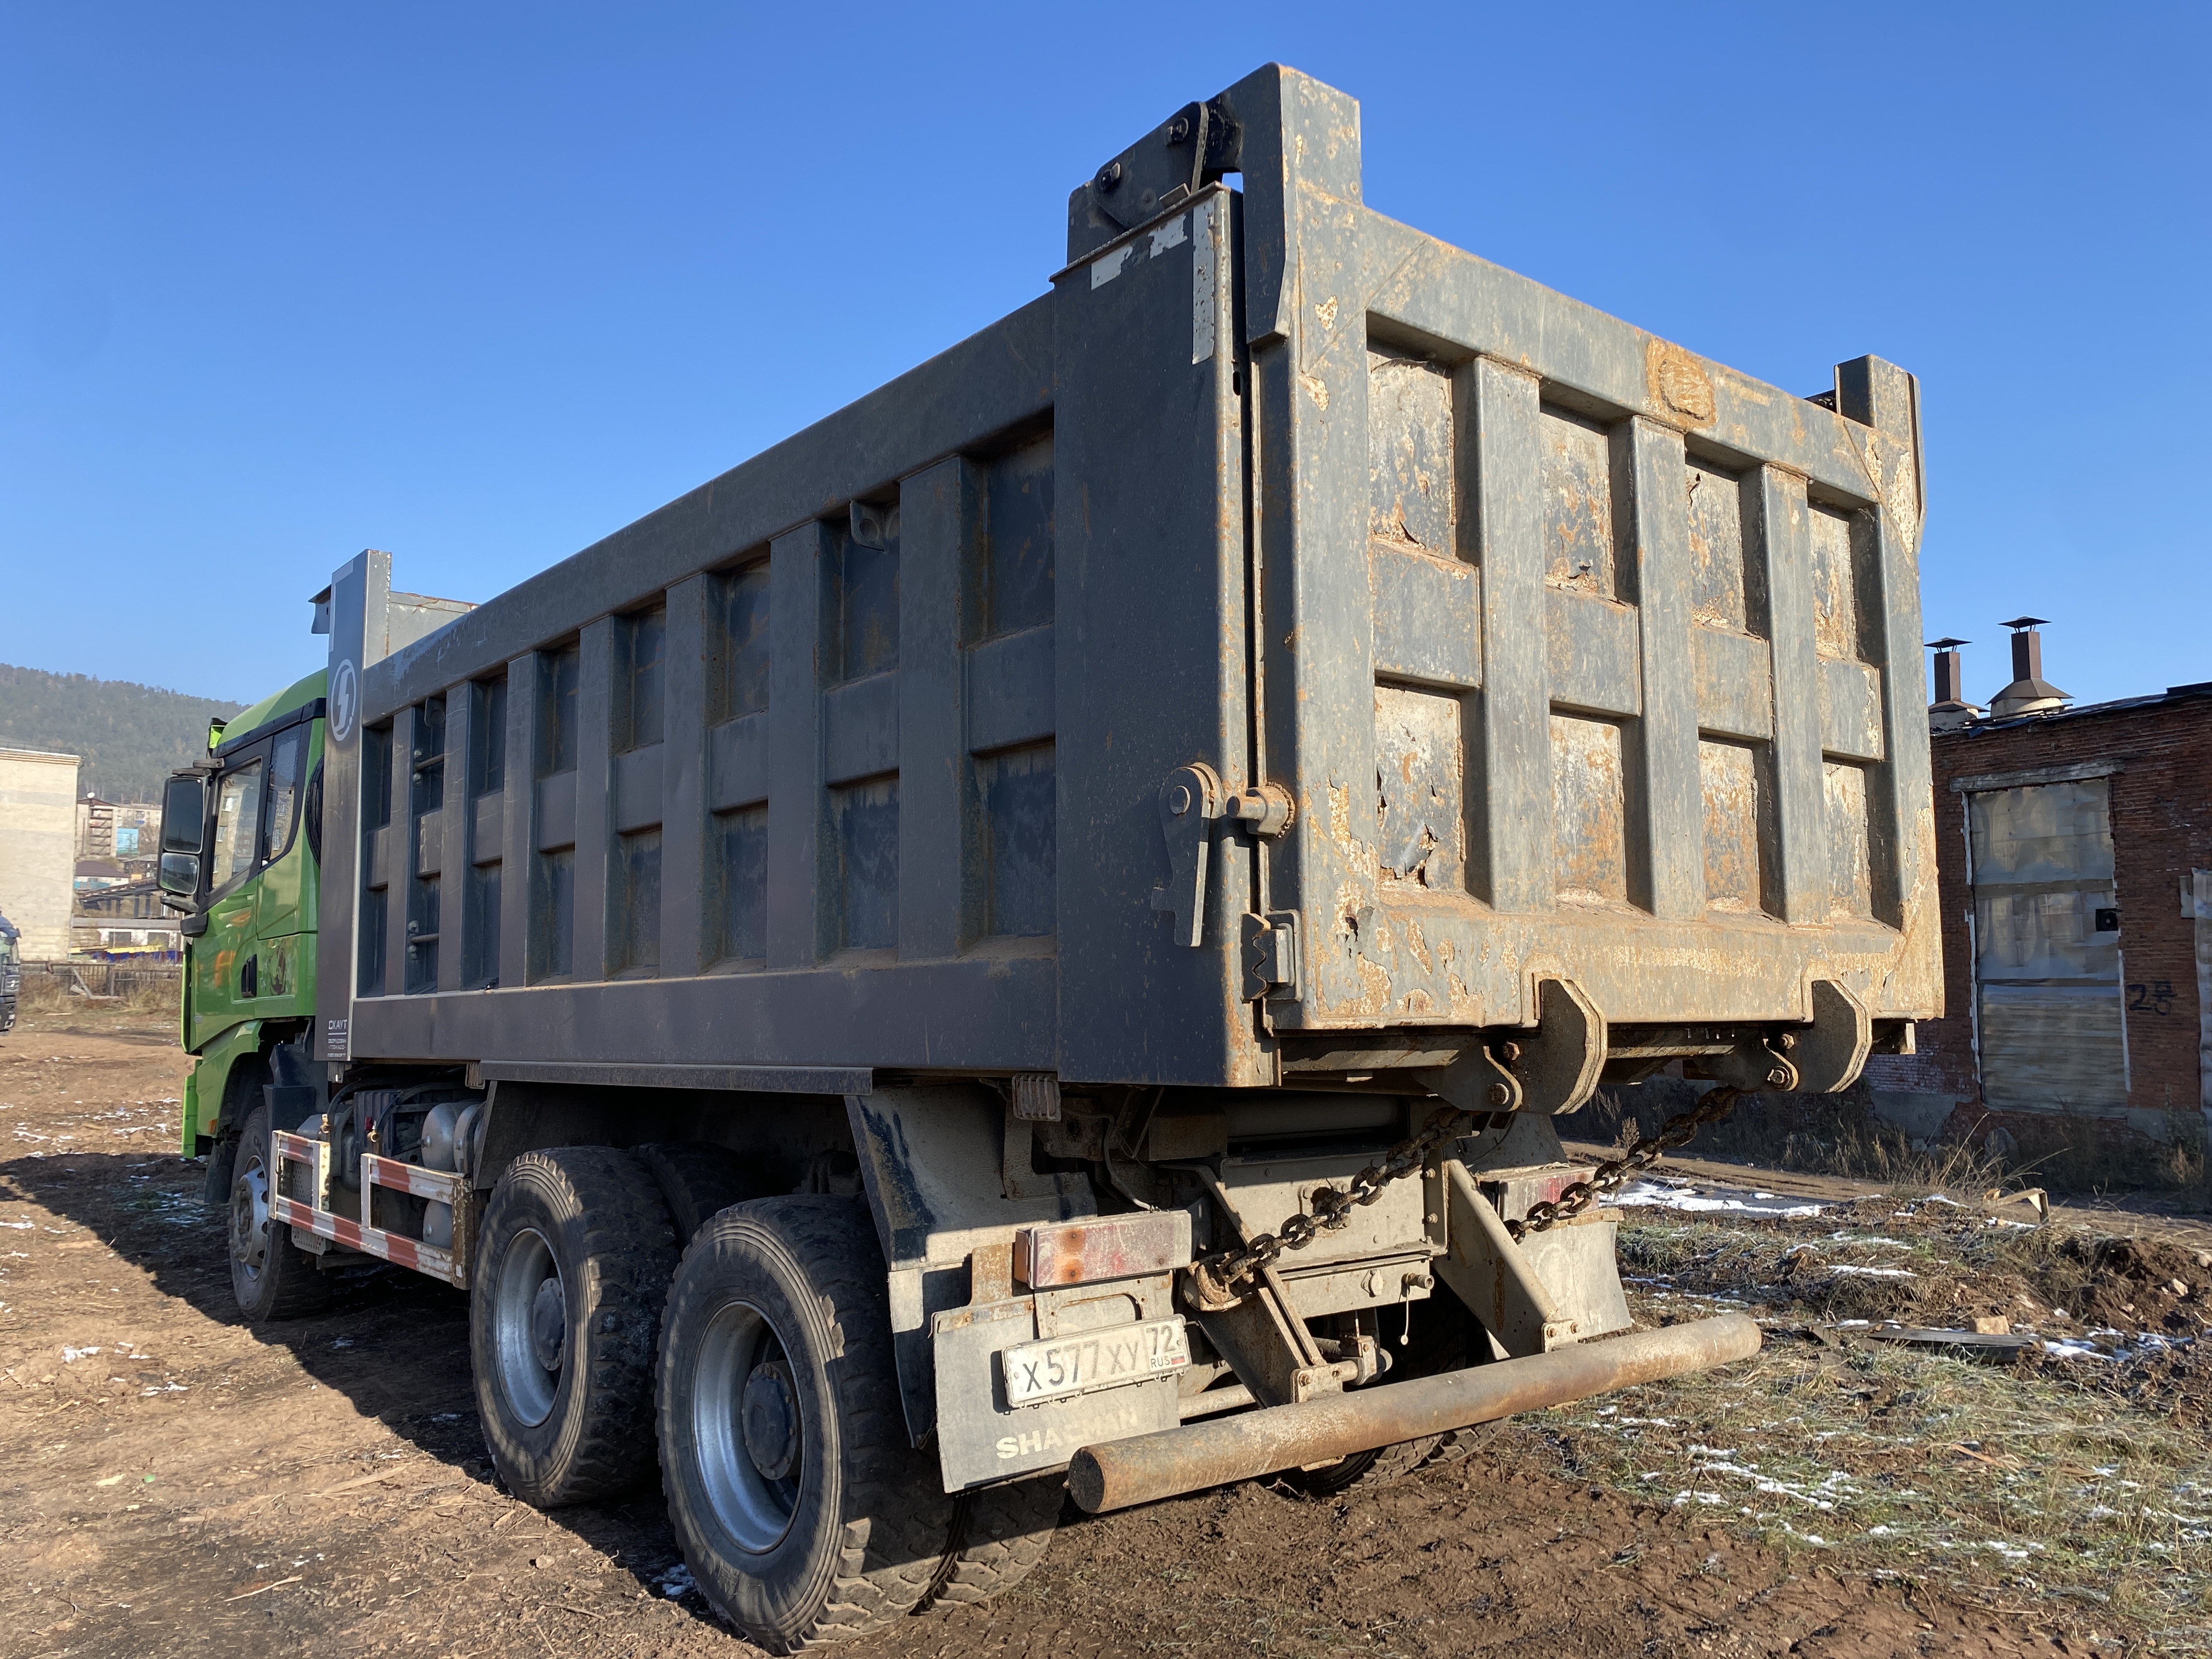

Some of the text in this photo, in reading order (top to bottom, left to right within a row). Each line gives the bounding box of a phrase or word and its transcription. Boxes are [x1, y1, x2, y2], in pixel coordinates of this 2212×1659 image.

[328, 1019, 347, 1030] СКАУТ
[1146, 1325, 1175, 1355] 72
[1150, 1356, 1170, 1368] RUS
